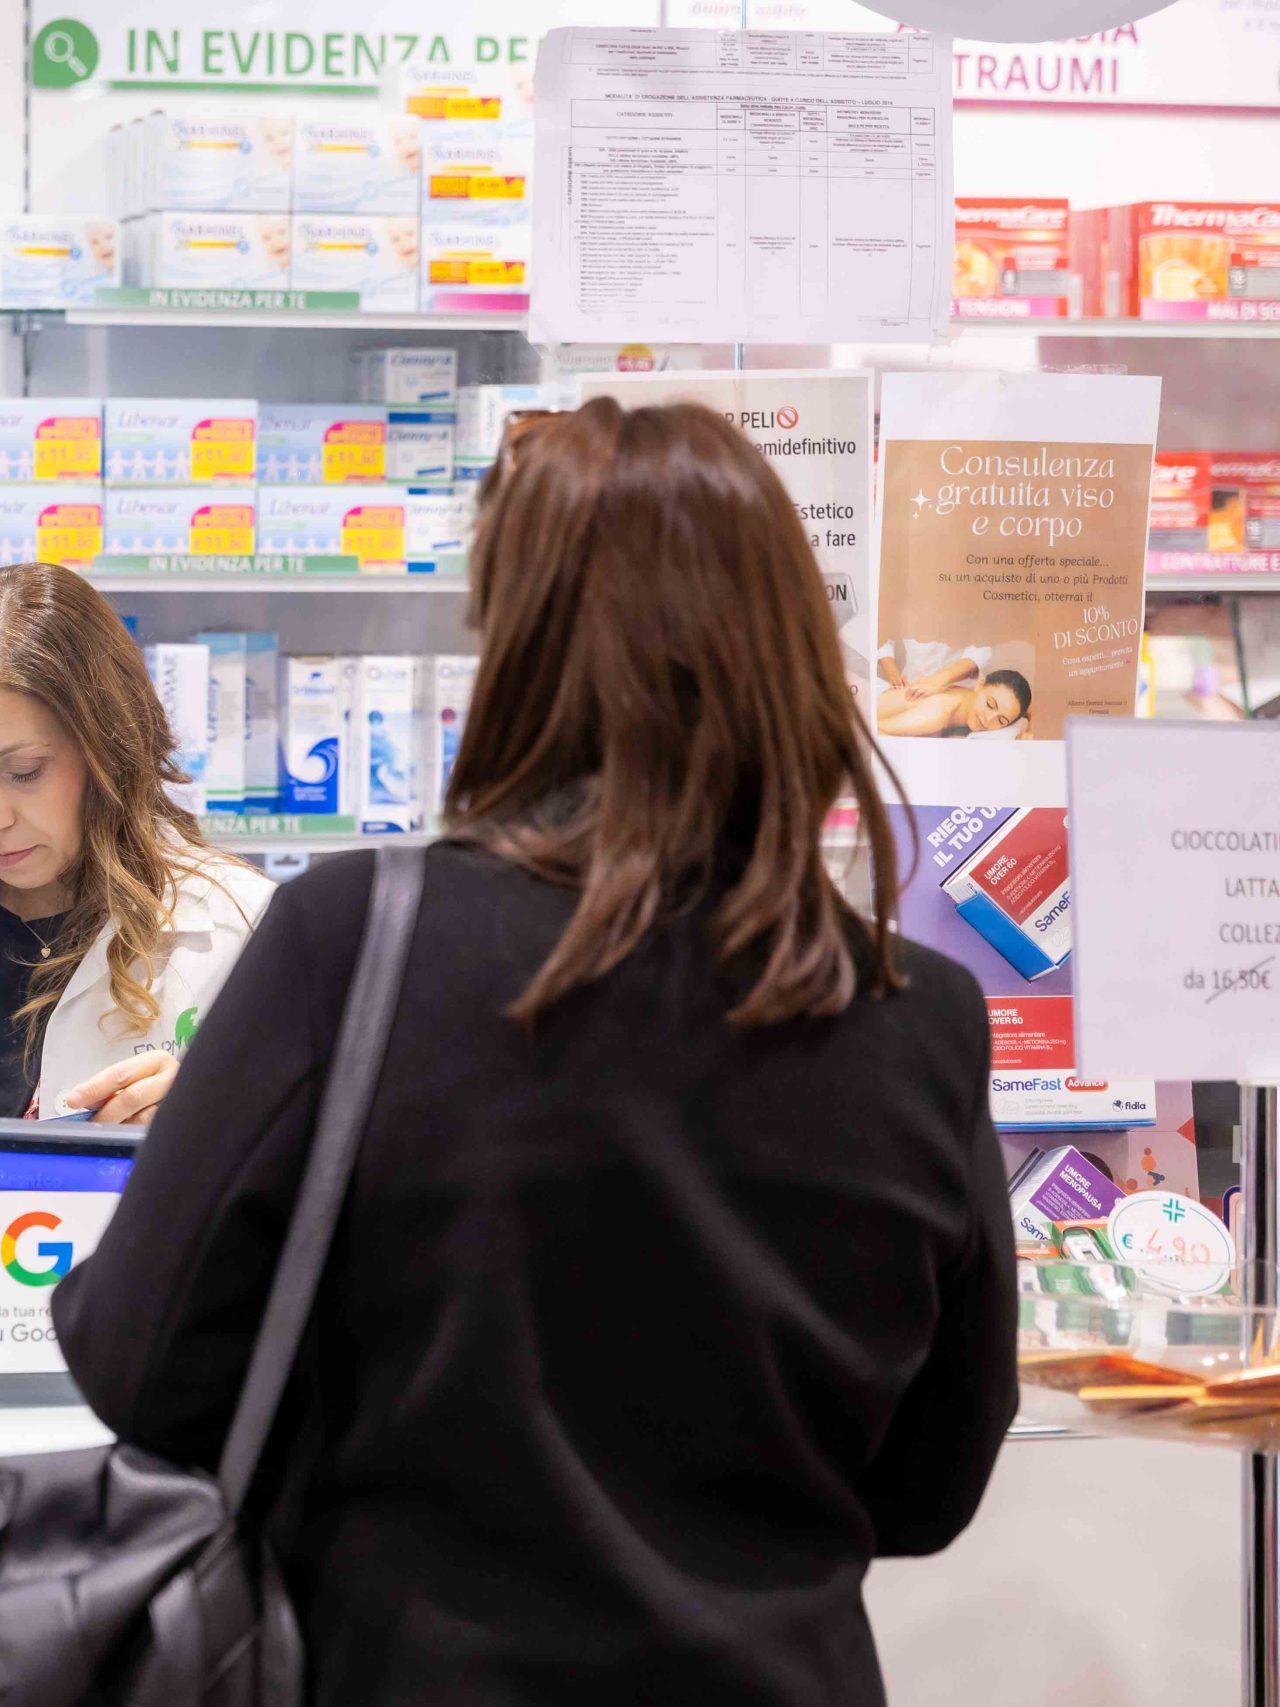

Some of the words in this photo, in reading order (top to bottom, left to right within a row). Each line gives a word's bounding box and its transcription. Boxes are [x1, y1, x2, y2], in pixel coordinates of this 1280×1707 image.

[128, 30, 180, 74] IN
[476, 36, 530, 63] PE
[953, 54, 1119, 93] TRAUMI
[741, 411, 775, 429] PELI
[940, 446, 1115, 479] Consulenza
[936, 481, 1051, 515] gratuita
[1061, 483, 1115, 508] viso
[826, 529, 856, 547] fare
[972, 515, 989, 536] e
[999, 515, 1083, 546] corpo
[966, 554, 989, 566] Con
[993, 556, 1015, 566] una
[1018, 555, 1056, 569] offerta
[938, 573, 952, 583] su
[956, 573, 971, 583] un
[974, 573, 1022, 586] acquisto
[1026, 573, 1037, 584] di
[1040, 575, 1060, 585] uno
[1093, 574, 1129, 586] Prodotti
[983, 590, 1041, 604] Cosmetici,
[1044, 591, 1083, 602] otterrai
[1083, 604, 1110, 625] 10%
[1054, 630, 1072, 649] DI
[1075, 618, 1138, 646] SCONTO
[932, 851, 954, 868] IL
[948, 817, 984, 850] TUO
[1171, 830, 1280, 851] CIOCCOLATI
[984, 854, 1009, 880] UMORE
[990, 866, 1010, 885] OVER
[1006, 857, 1018, 872] 60
[1225, 877, 1280, 898] LATTA
[1183, 968, 1205, 989] da
[988, 1009, 1018, 1017] UMORE
[989, 1017, 1011, 1025] OVER
[1012, 1017, 1024, 1025] 60
[992, 1078, 1062, 1092] SameFast
[1064, 1164, 1092, 1190] UMORE
[1060, 1170, 1103, 1211] MENOPAUSA
[13, 1306, 35, 1318] tua
